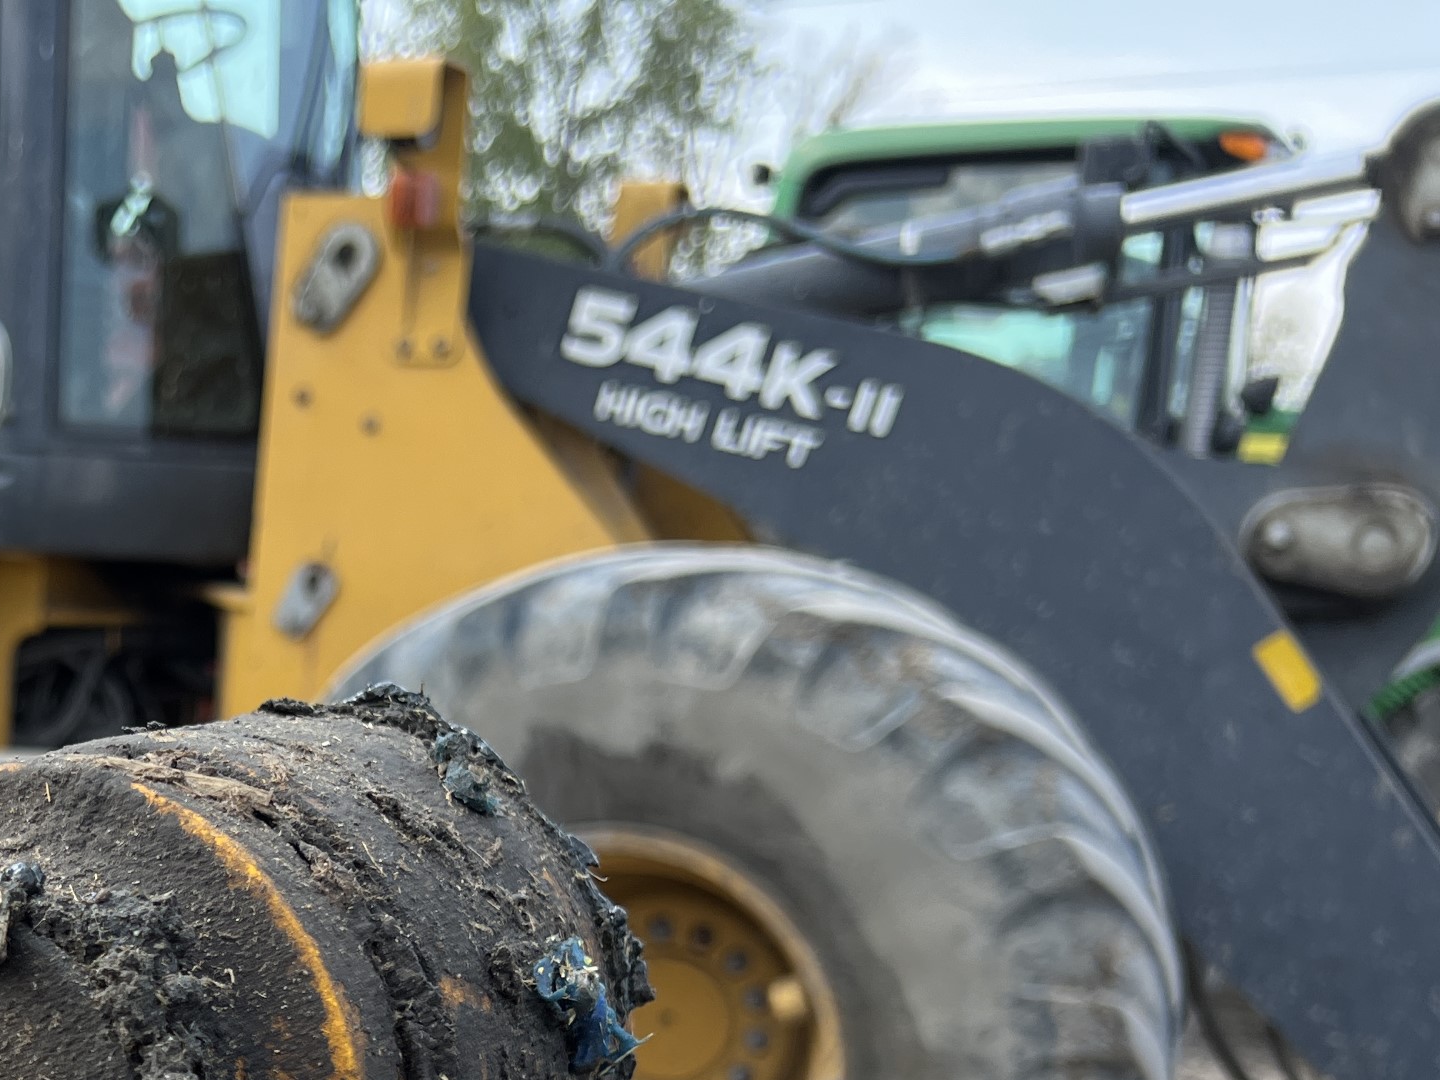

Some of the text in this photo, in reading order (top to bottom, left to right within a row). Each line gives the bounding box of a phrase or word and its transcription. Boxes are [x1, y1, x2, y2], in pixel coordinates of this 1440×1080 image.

[561, 287, 904, 437] 544K-II
[594, 380, 824, 469] HIGH LIFT
